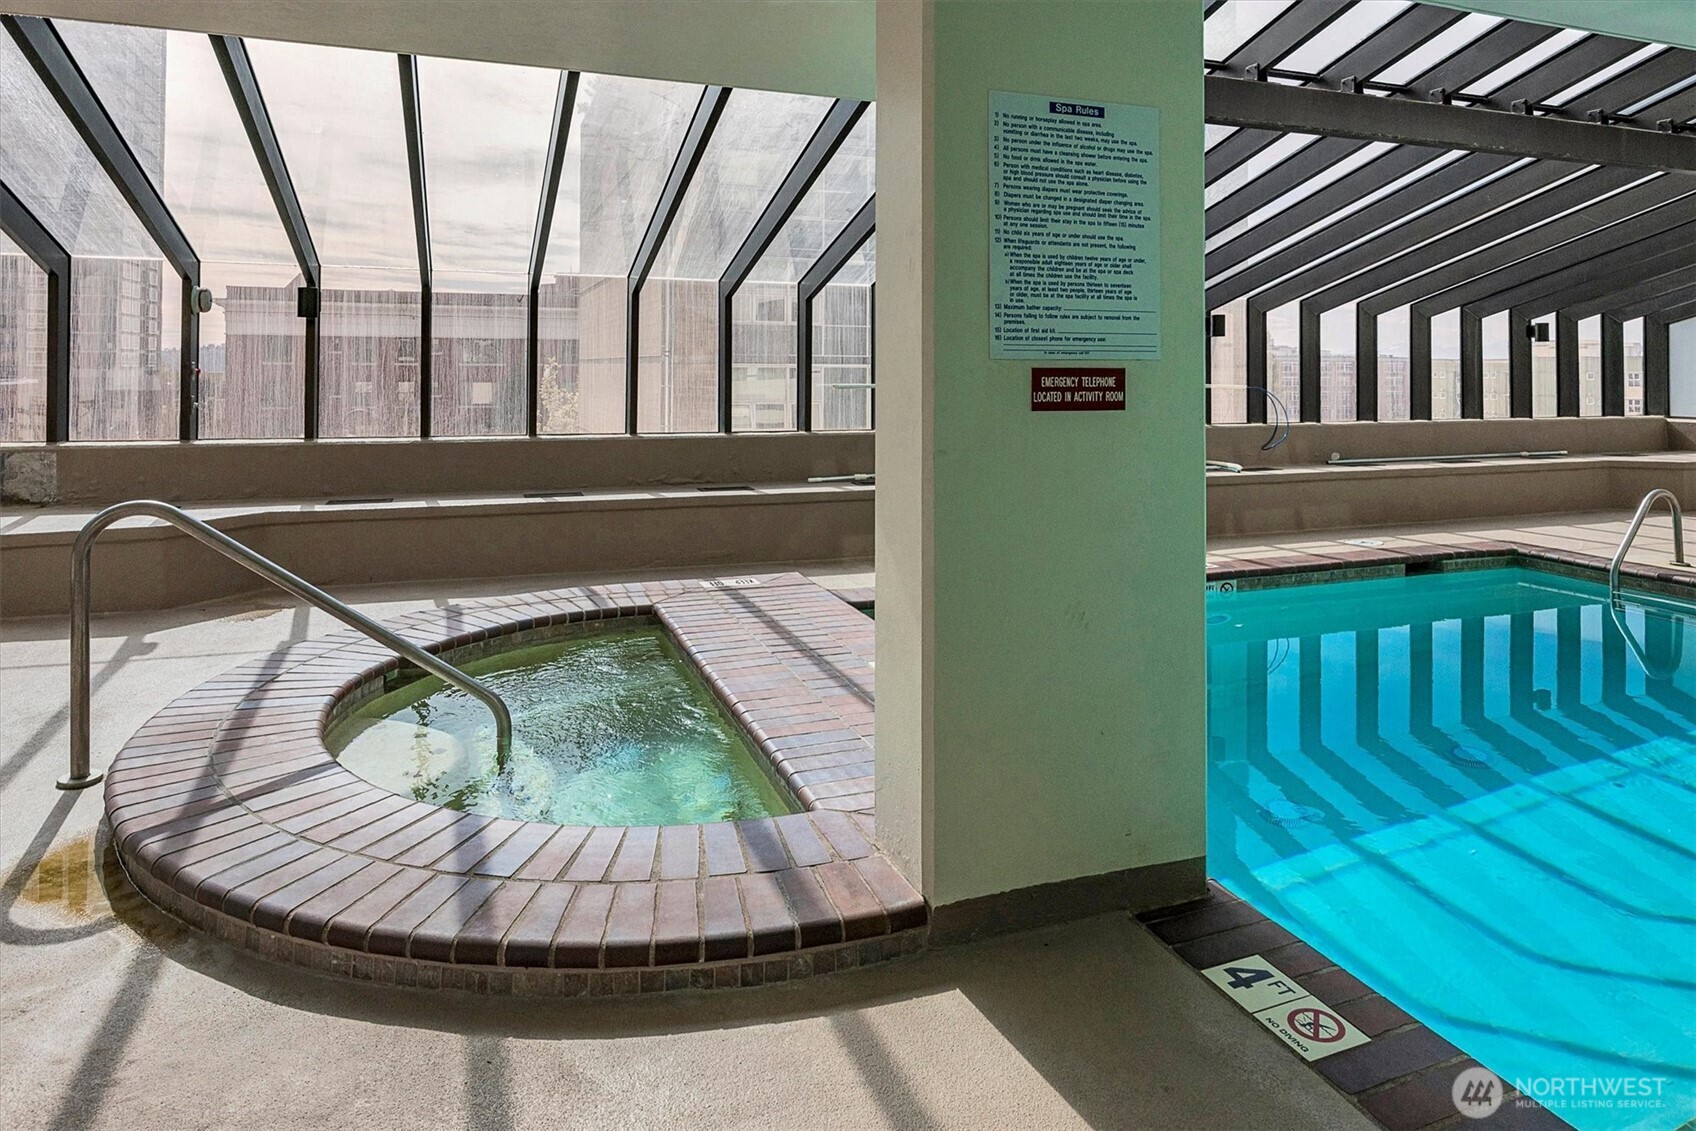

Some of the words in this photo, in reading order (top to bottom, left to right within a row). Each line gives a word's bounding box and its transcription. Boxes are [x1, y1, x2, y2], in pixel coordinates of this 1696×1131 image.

[1055, 103, 1073, 114] Spa
[1075, 105, 1100, 116] Rules
[1035, 116, 1057, 124] horseplay
[1041, 376, 1079, 388] EMERGENCY
[1081, 376, 1117, 388] TELEPHONE
[1033, 391, 1062, 403] LOCATED
[1064, 391, 1072, 402] IN
[1073, 391, 1104, 402] ACTIVITY
[1105, 391, 1124, 402] ROOM
[1223, 967, 1275, 990] 4
[1267, 980, 1297, 995] FT
[1265, 1017, 1280, 1028] NO
[1279, 1028, 1310, 1053] DIVING
